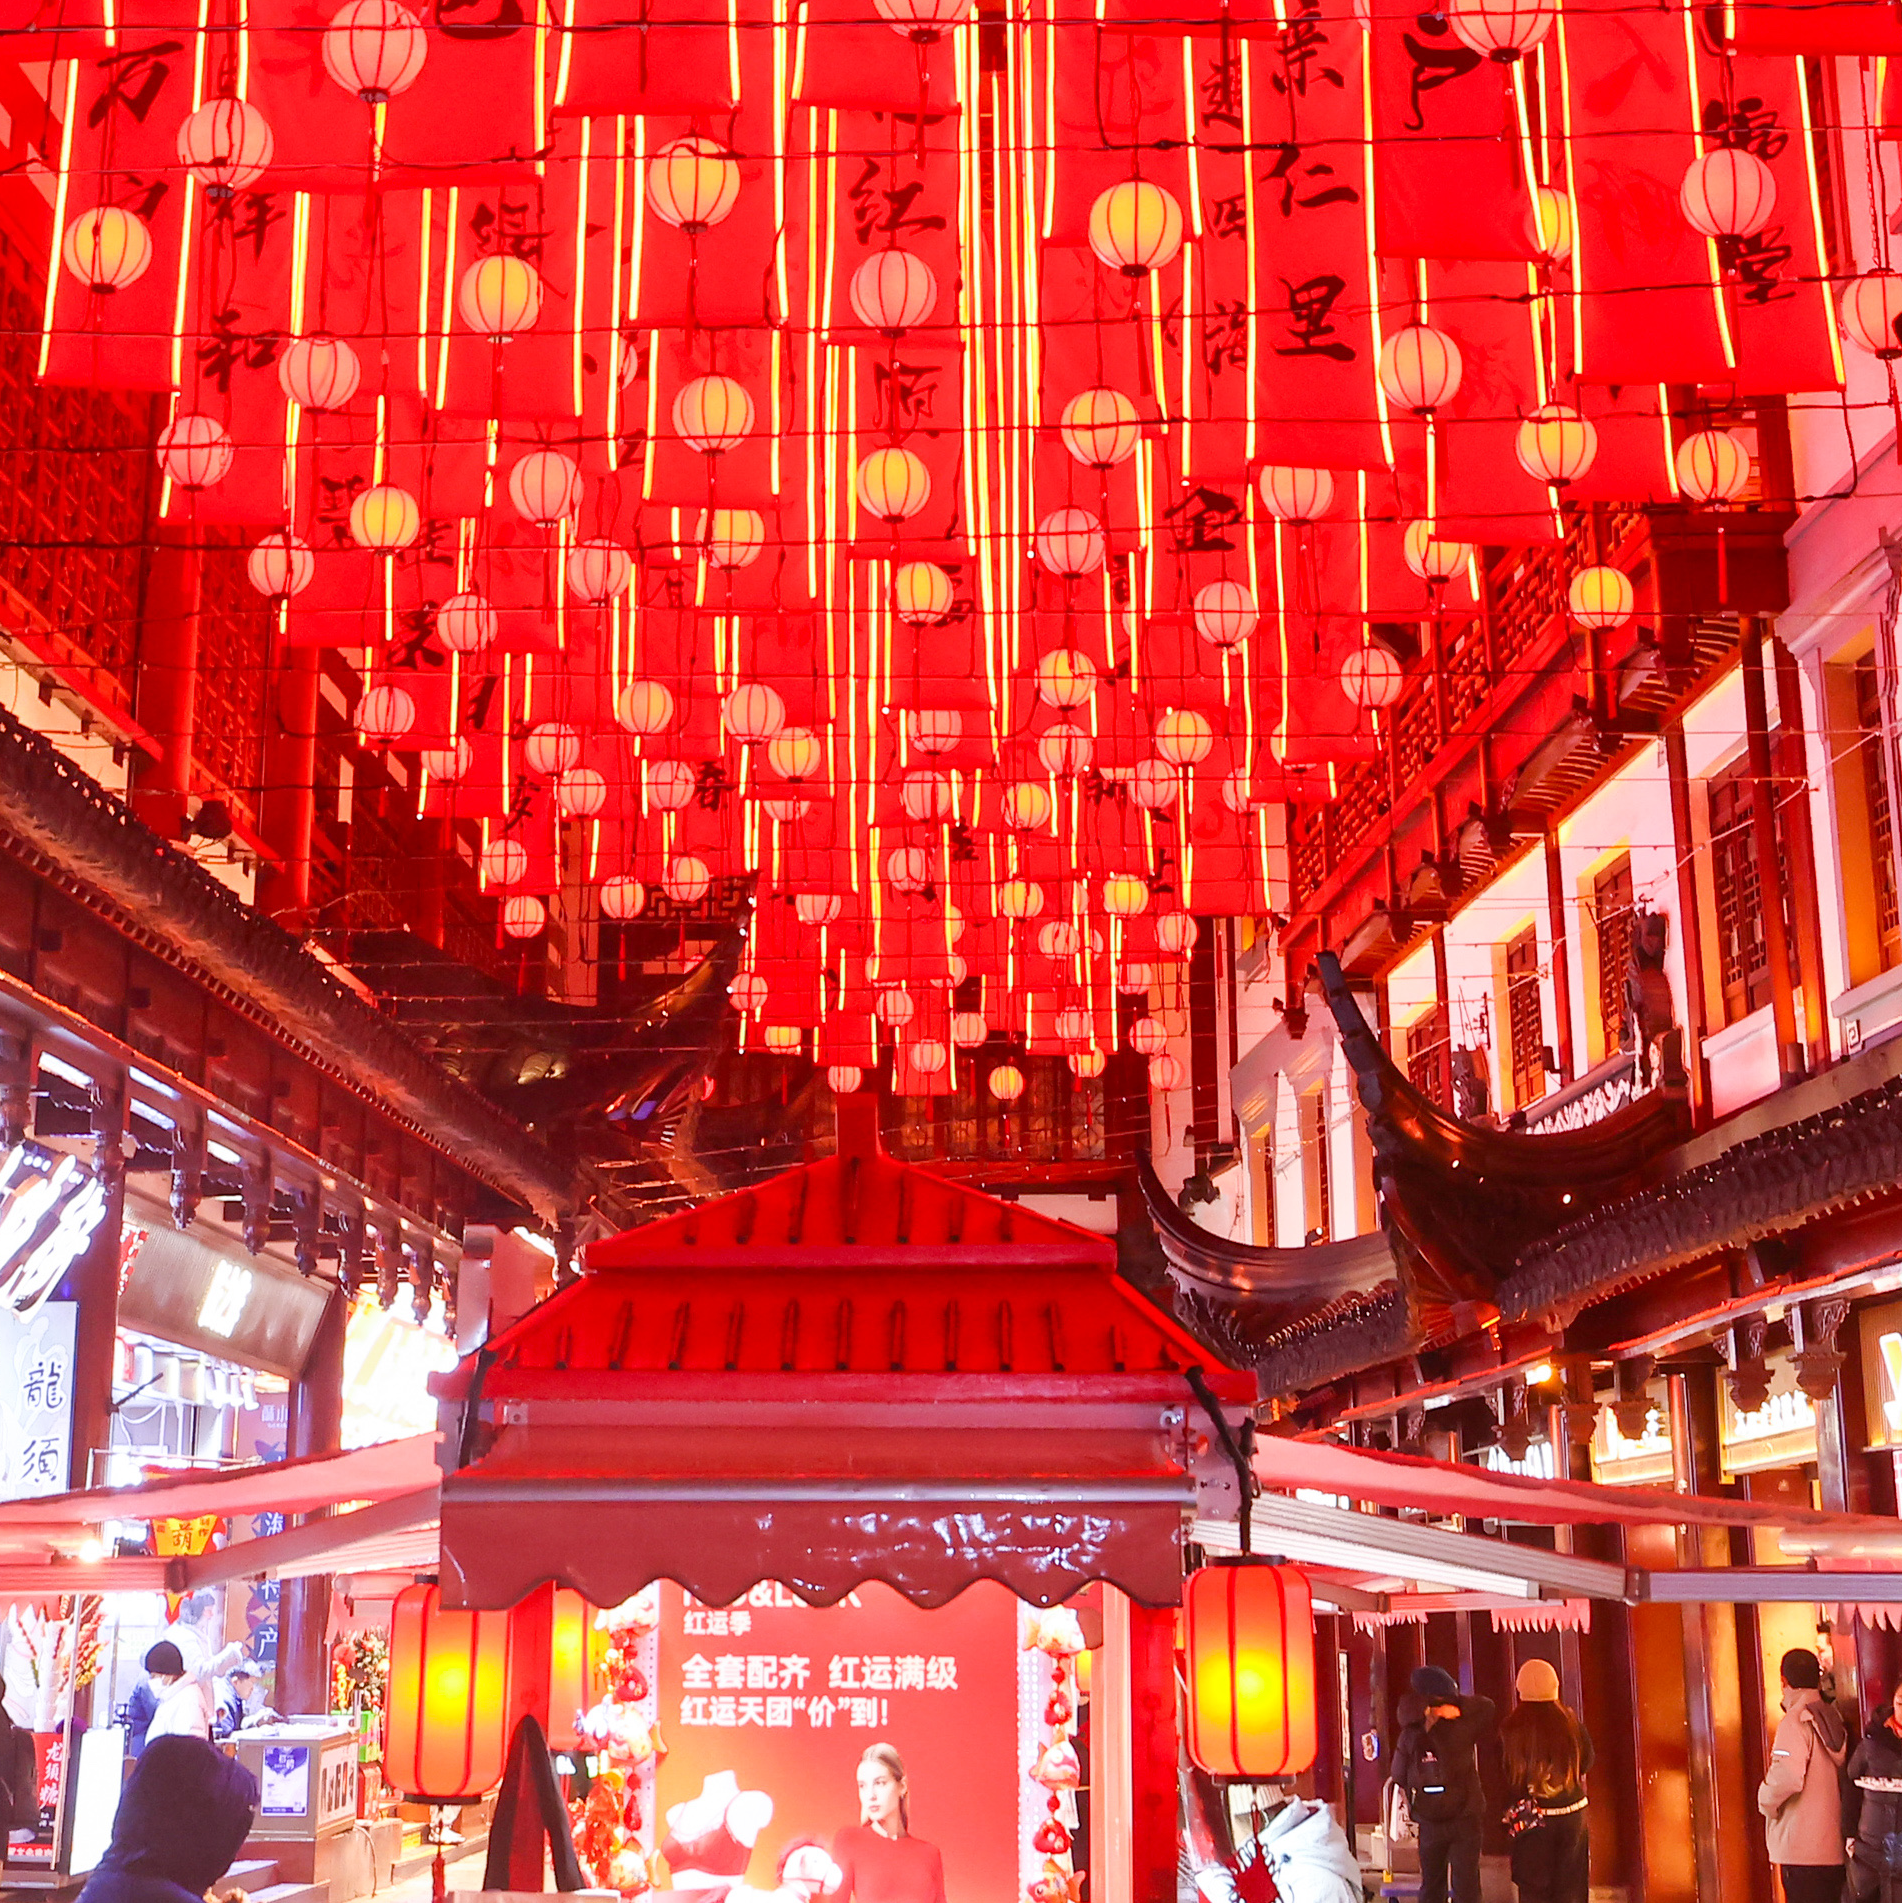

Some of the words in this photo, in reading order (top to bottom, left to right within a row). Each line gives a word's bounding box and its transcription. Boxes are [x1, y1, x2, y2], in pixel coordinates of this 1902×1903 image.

[682, 1610, 752, 1637] 红运季
[680, 1653, 811, 1691] 全套配齐
[828, 1653, 959, 1692] 红运满级
